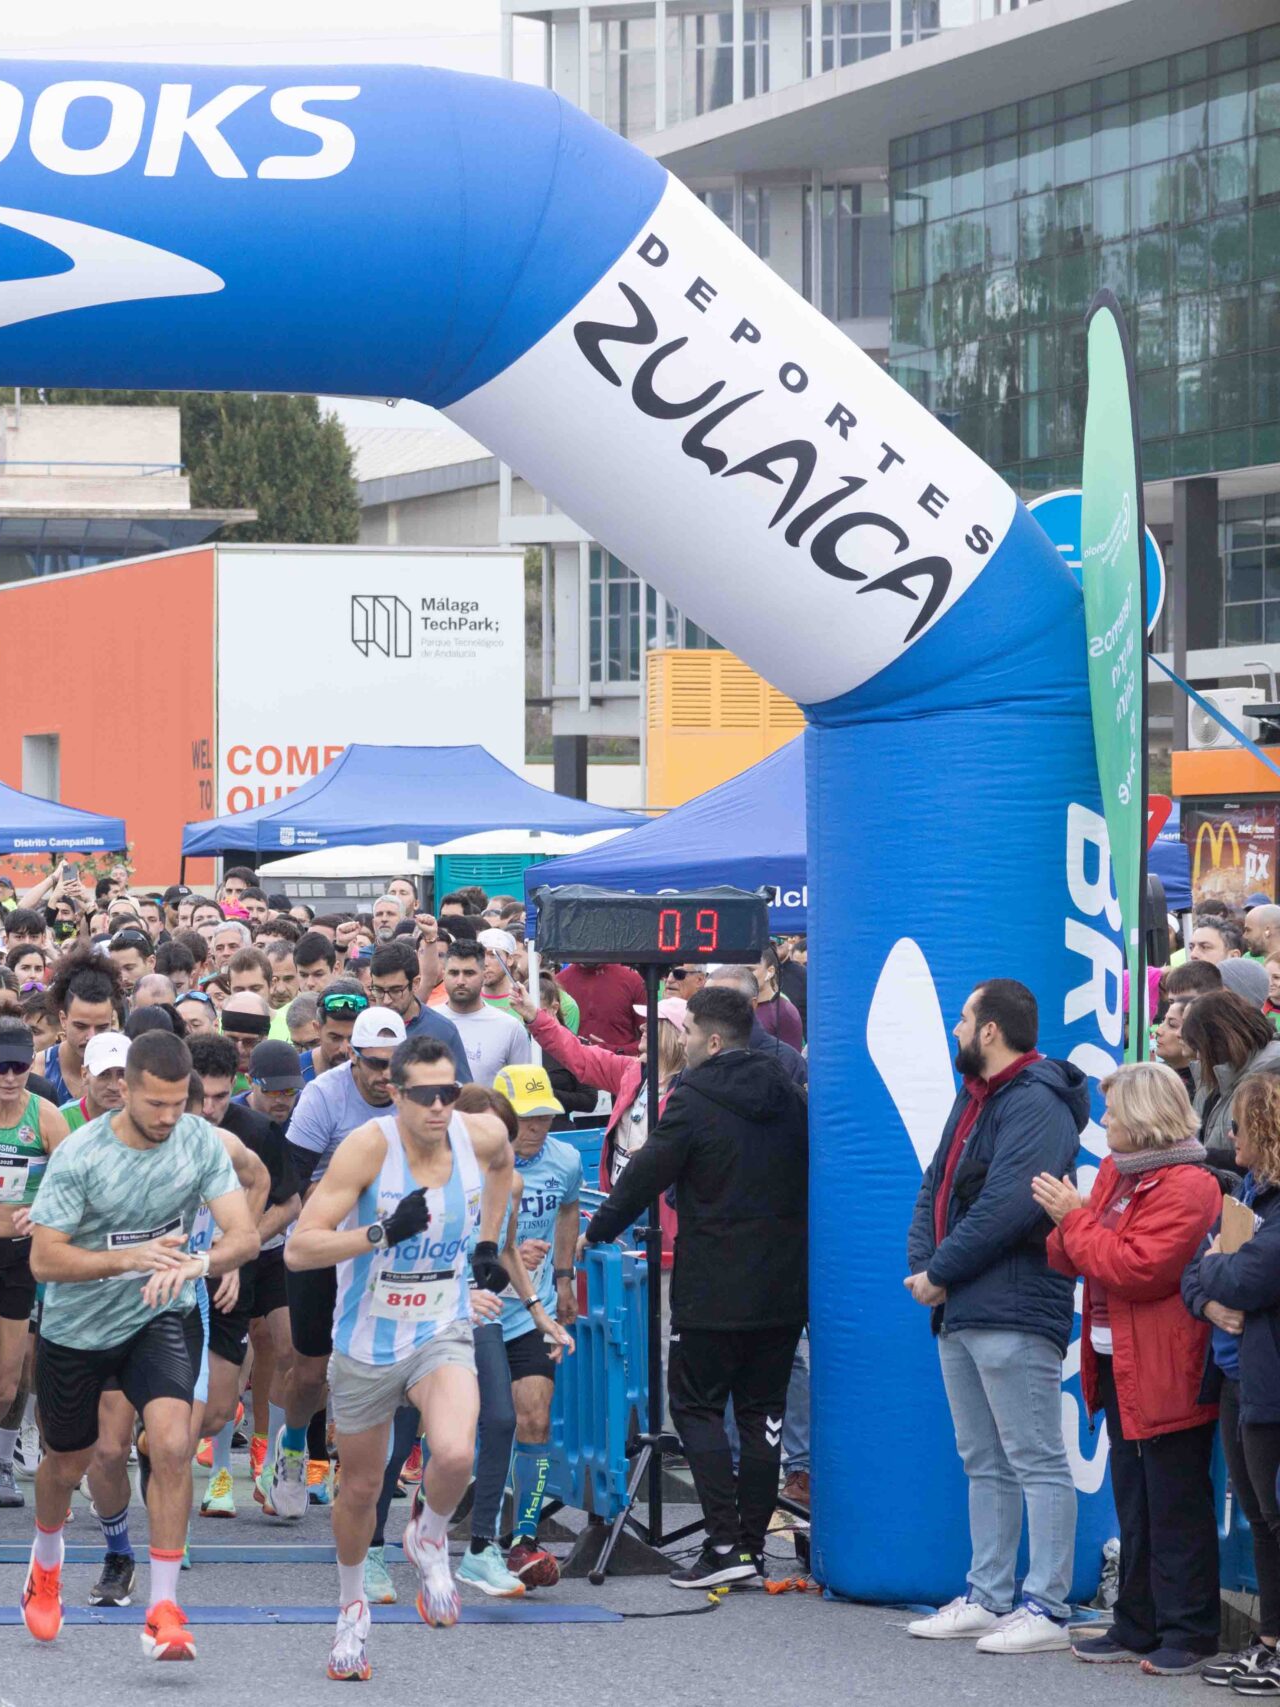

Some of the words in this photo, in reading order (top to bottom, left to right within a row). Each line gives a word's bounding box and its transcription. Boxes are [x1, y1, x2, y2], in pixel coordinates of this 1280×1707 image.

[638, 232, 993, 555] DEPORTES
[573, 281, 956, 643] ZULAICA
[421, 597, 479, 614] Málaga
[421, 617, 500, 633] TechPark;
[421, 638, 451, 648] Parque
[454, 637, 504, 649] Tecnológico
[421, 649, 433, 658] de
[435, 649, 476, 658] Andalucía
[191, 739, 212, 769] WEL
[199, 780, 212, 810] TO
[14, 838, 47, 848] Distrito
[49, 836, 105, 848] Campanillas
[387, 1292, 427, 1307] 810
[524, 1458, 550, 1519] Kalenji
